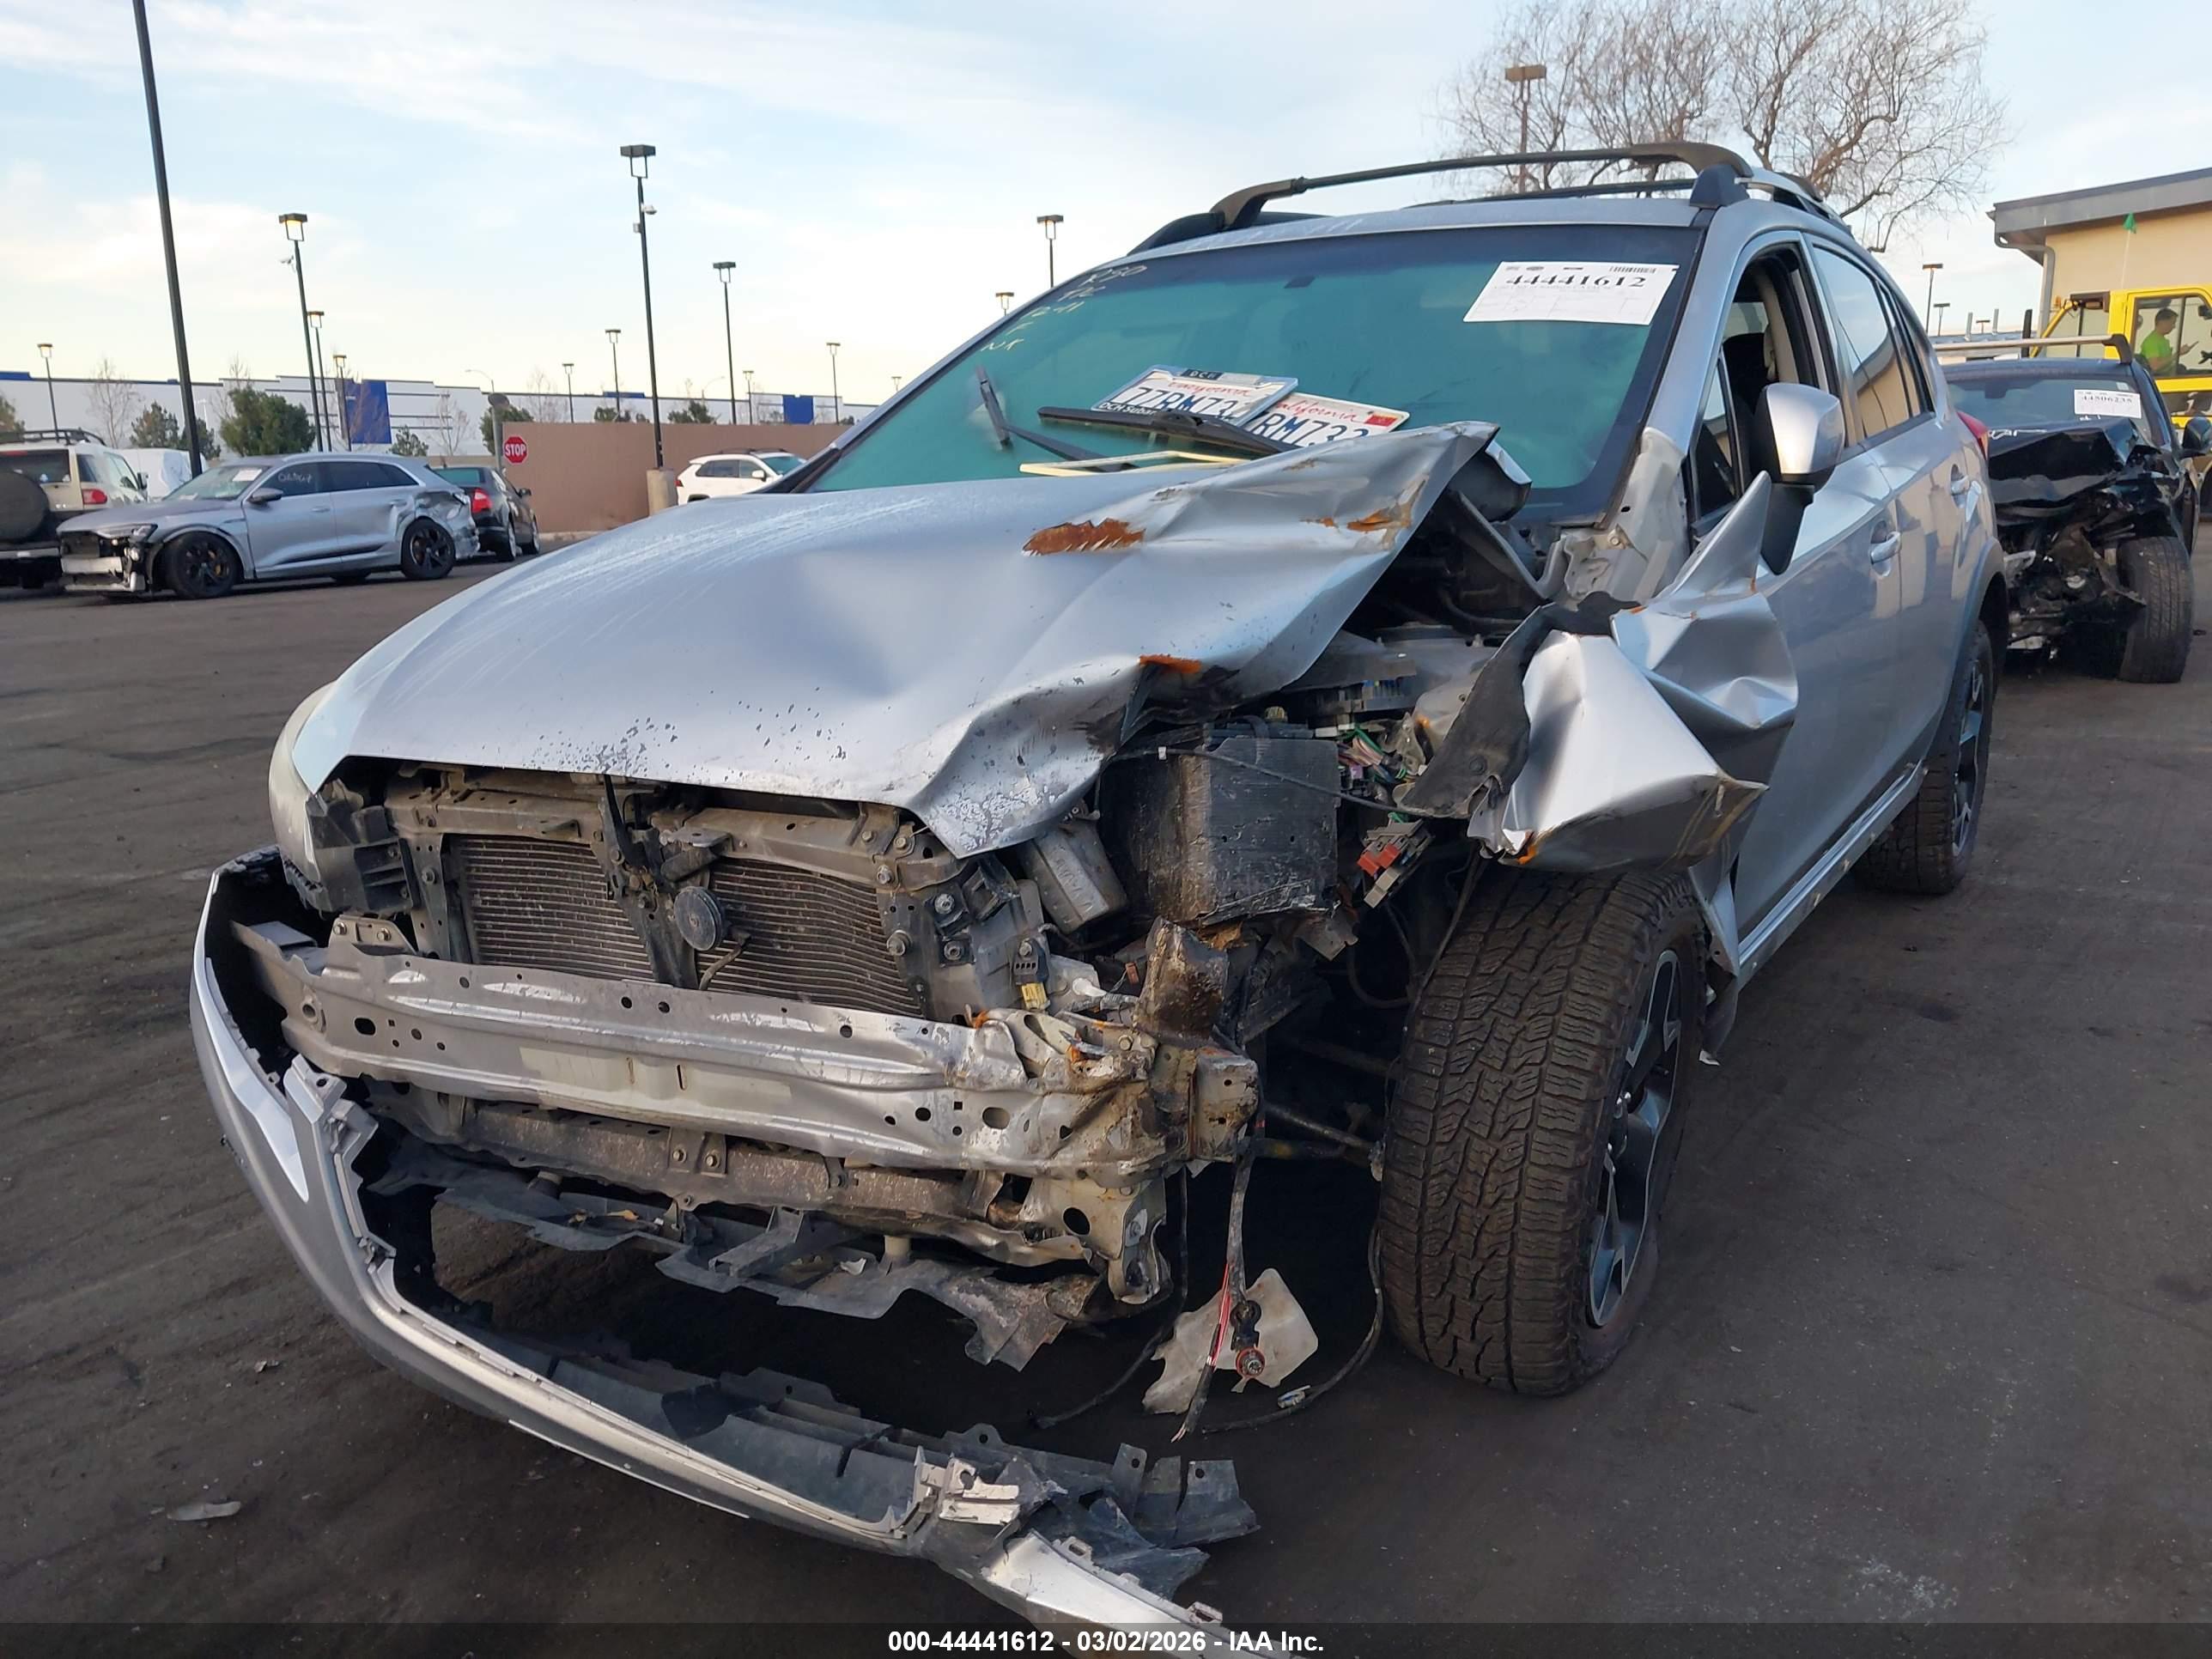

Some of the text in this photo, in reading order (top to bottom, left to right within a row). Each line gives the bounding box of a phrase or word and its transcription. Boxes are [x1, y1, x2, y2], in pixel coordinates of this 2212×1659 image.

[1505, 273, 1647, 288] 44441612
[1189, 370, 1217, 379] DCH
[1098, 401, 1158, 416] DCH Subar
[1276, 399, 1365, 423] alifornia
[505, 443, 526, 457] STOP
